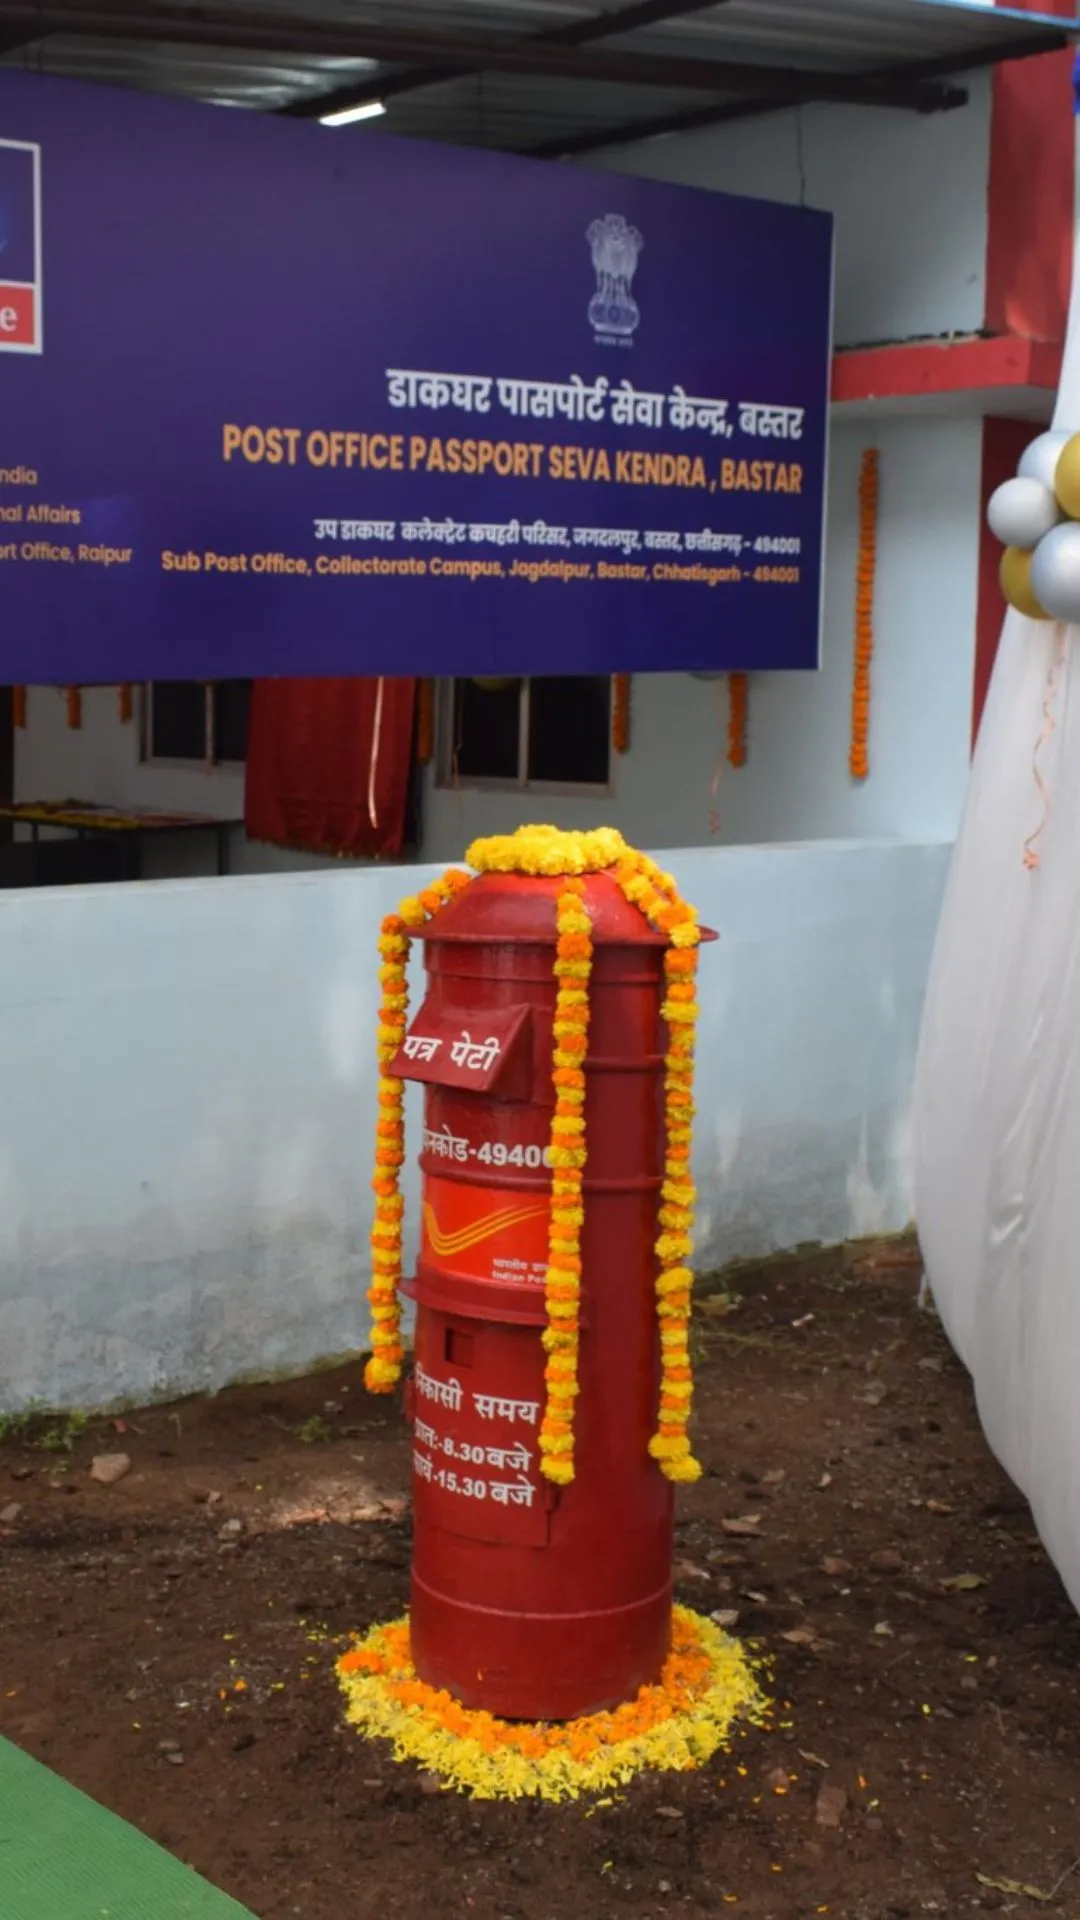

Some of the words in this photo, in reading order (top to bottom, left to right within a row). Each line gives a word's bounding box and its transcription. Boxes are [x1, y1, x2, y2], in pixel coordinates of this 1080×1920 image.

[385, 368, 493, 413] डाकघर
[496, 373, 609, 422] पासपोर्ट
[609, 379, 665, 428] सेवा
[738, 401, 805, 440] बस्तर
[222, 423, 301, 466] POST
[305, 429, 404, 470] OFFICE
[409, 434, 545, 477] PASSPORT
[548, 444, 611, 483] SEVA
[721, 457, 804, 494] BASTAR
[27, 505, 82, 525] Affairs
[313, 518, 339, 541] उप
[340, 518, 396, 542] डाकघर
[468, 518, 520, 546] कचहरी
[21, 542, 75, 564] Office,
[78, 544, 133, 567] Raipur
[161, 550, 201, 572] Sub
[204, 551, 248, 573] Post
[251, 553, 312, 576] Office,
[315, 554, 427, 576] Collectorate
[429, 556, 506, 582] Campus,
[508, 558, 595, 583] Jagdalpur,
[403, 1035, 443, 1062] पत्र
[451, 1030, 501, 1071] पेटी
[472, 1393, 540, 1425] समय
[485, 1442, 533, 1472] बजे
[488, 1474, 536, 1507] बजे
